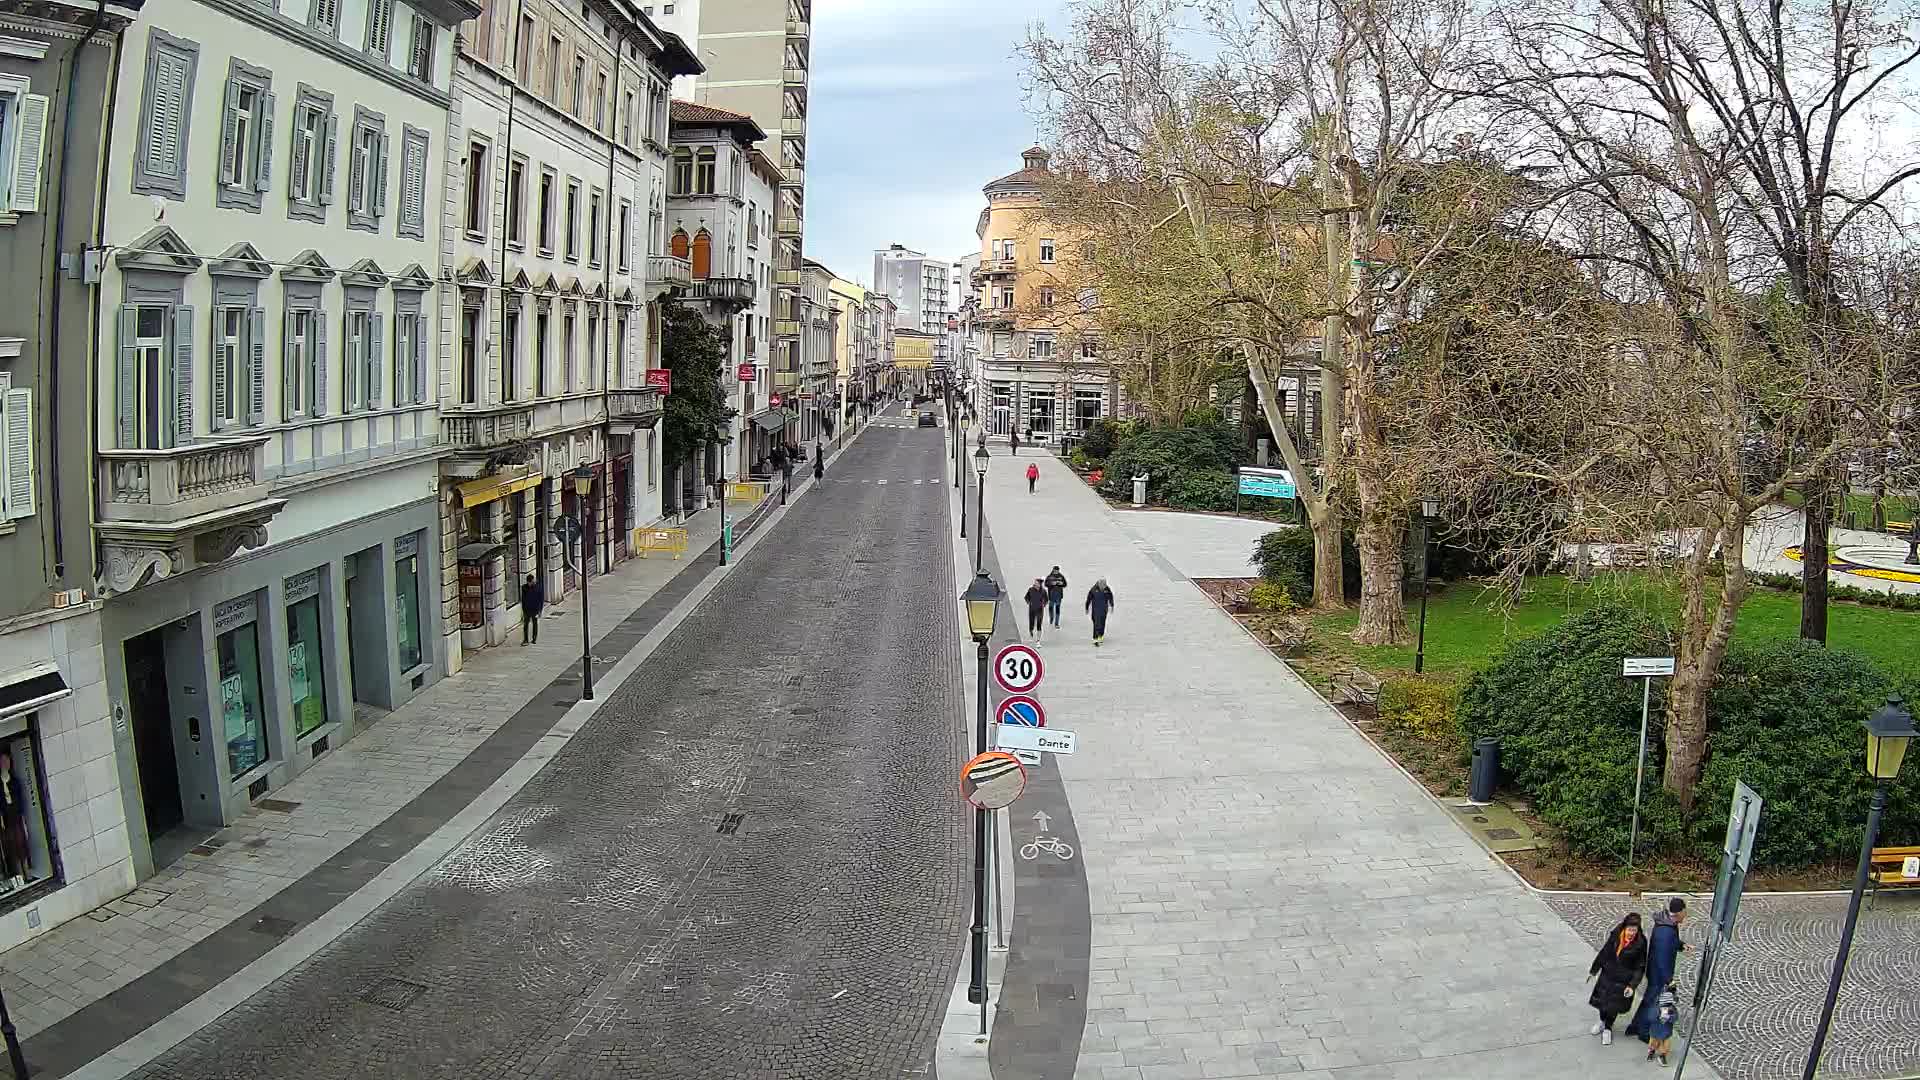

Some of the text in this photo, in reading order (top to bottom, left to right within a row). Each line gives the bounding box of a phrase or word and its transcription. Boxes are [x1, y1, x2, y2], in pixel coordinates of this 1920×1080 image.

[1005, 658, 1033, 680] 30
[222, 677, 241, 701] 130
[1038, 737, 1070, 749] Dante
